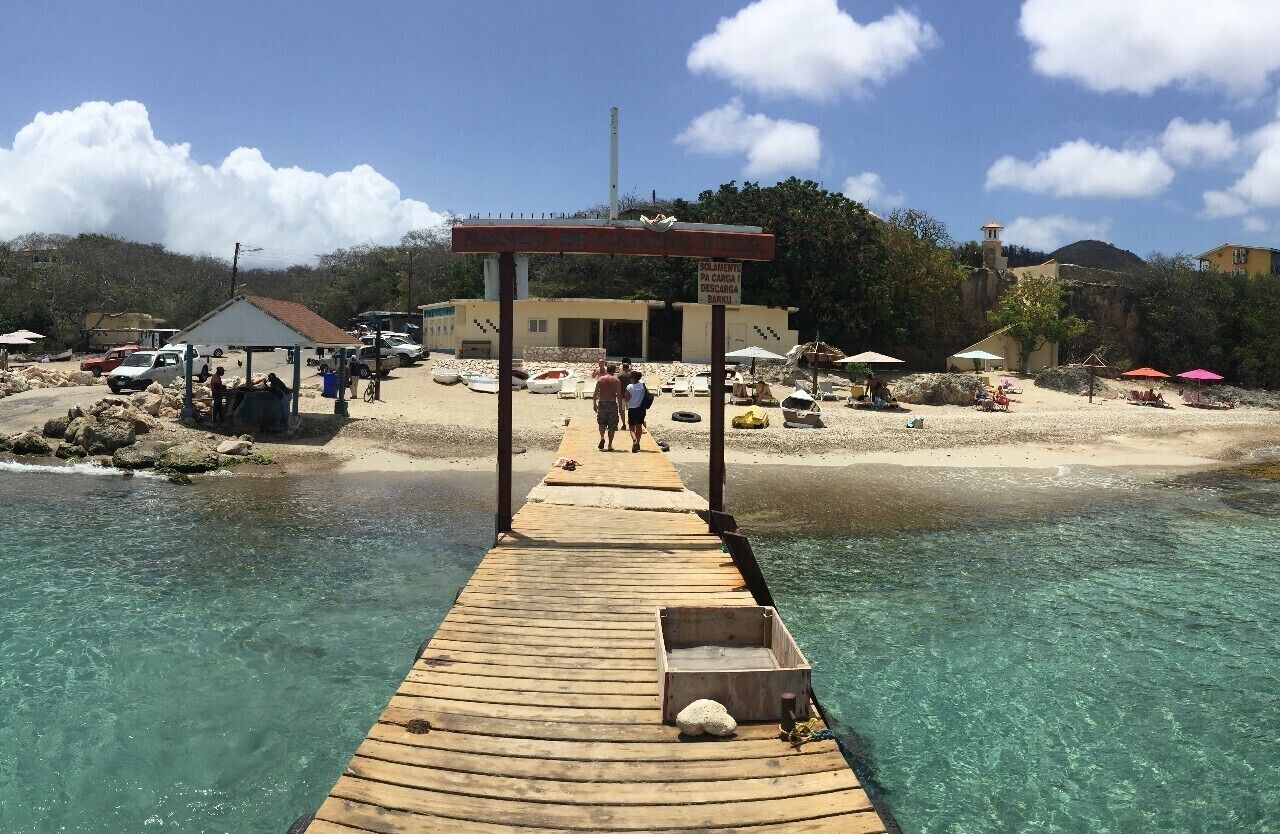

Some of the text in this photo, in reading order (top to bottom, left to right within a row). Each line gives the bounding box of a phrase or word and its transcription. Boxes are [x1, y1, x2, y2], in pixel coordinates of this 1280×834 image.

[700, 262, 741, 272] SOLAMENTE
[700, 273, 710, 282] PA
[711, 274, 736, 283] CARGA
[700, 284, 738, 293] DESCARGA
[708, 295, 732, 304] BARKU
